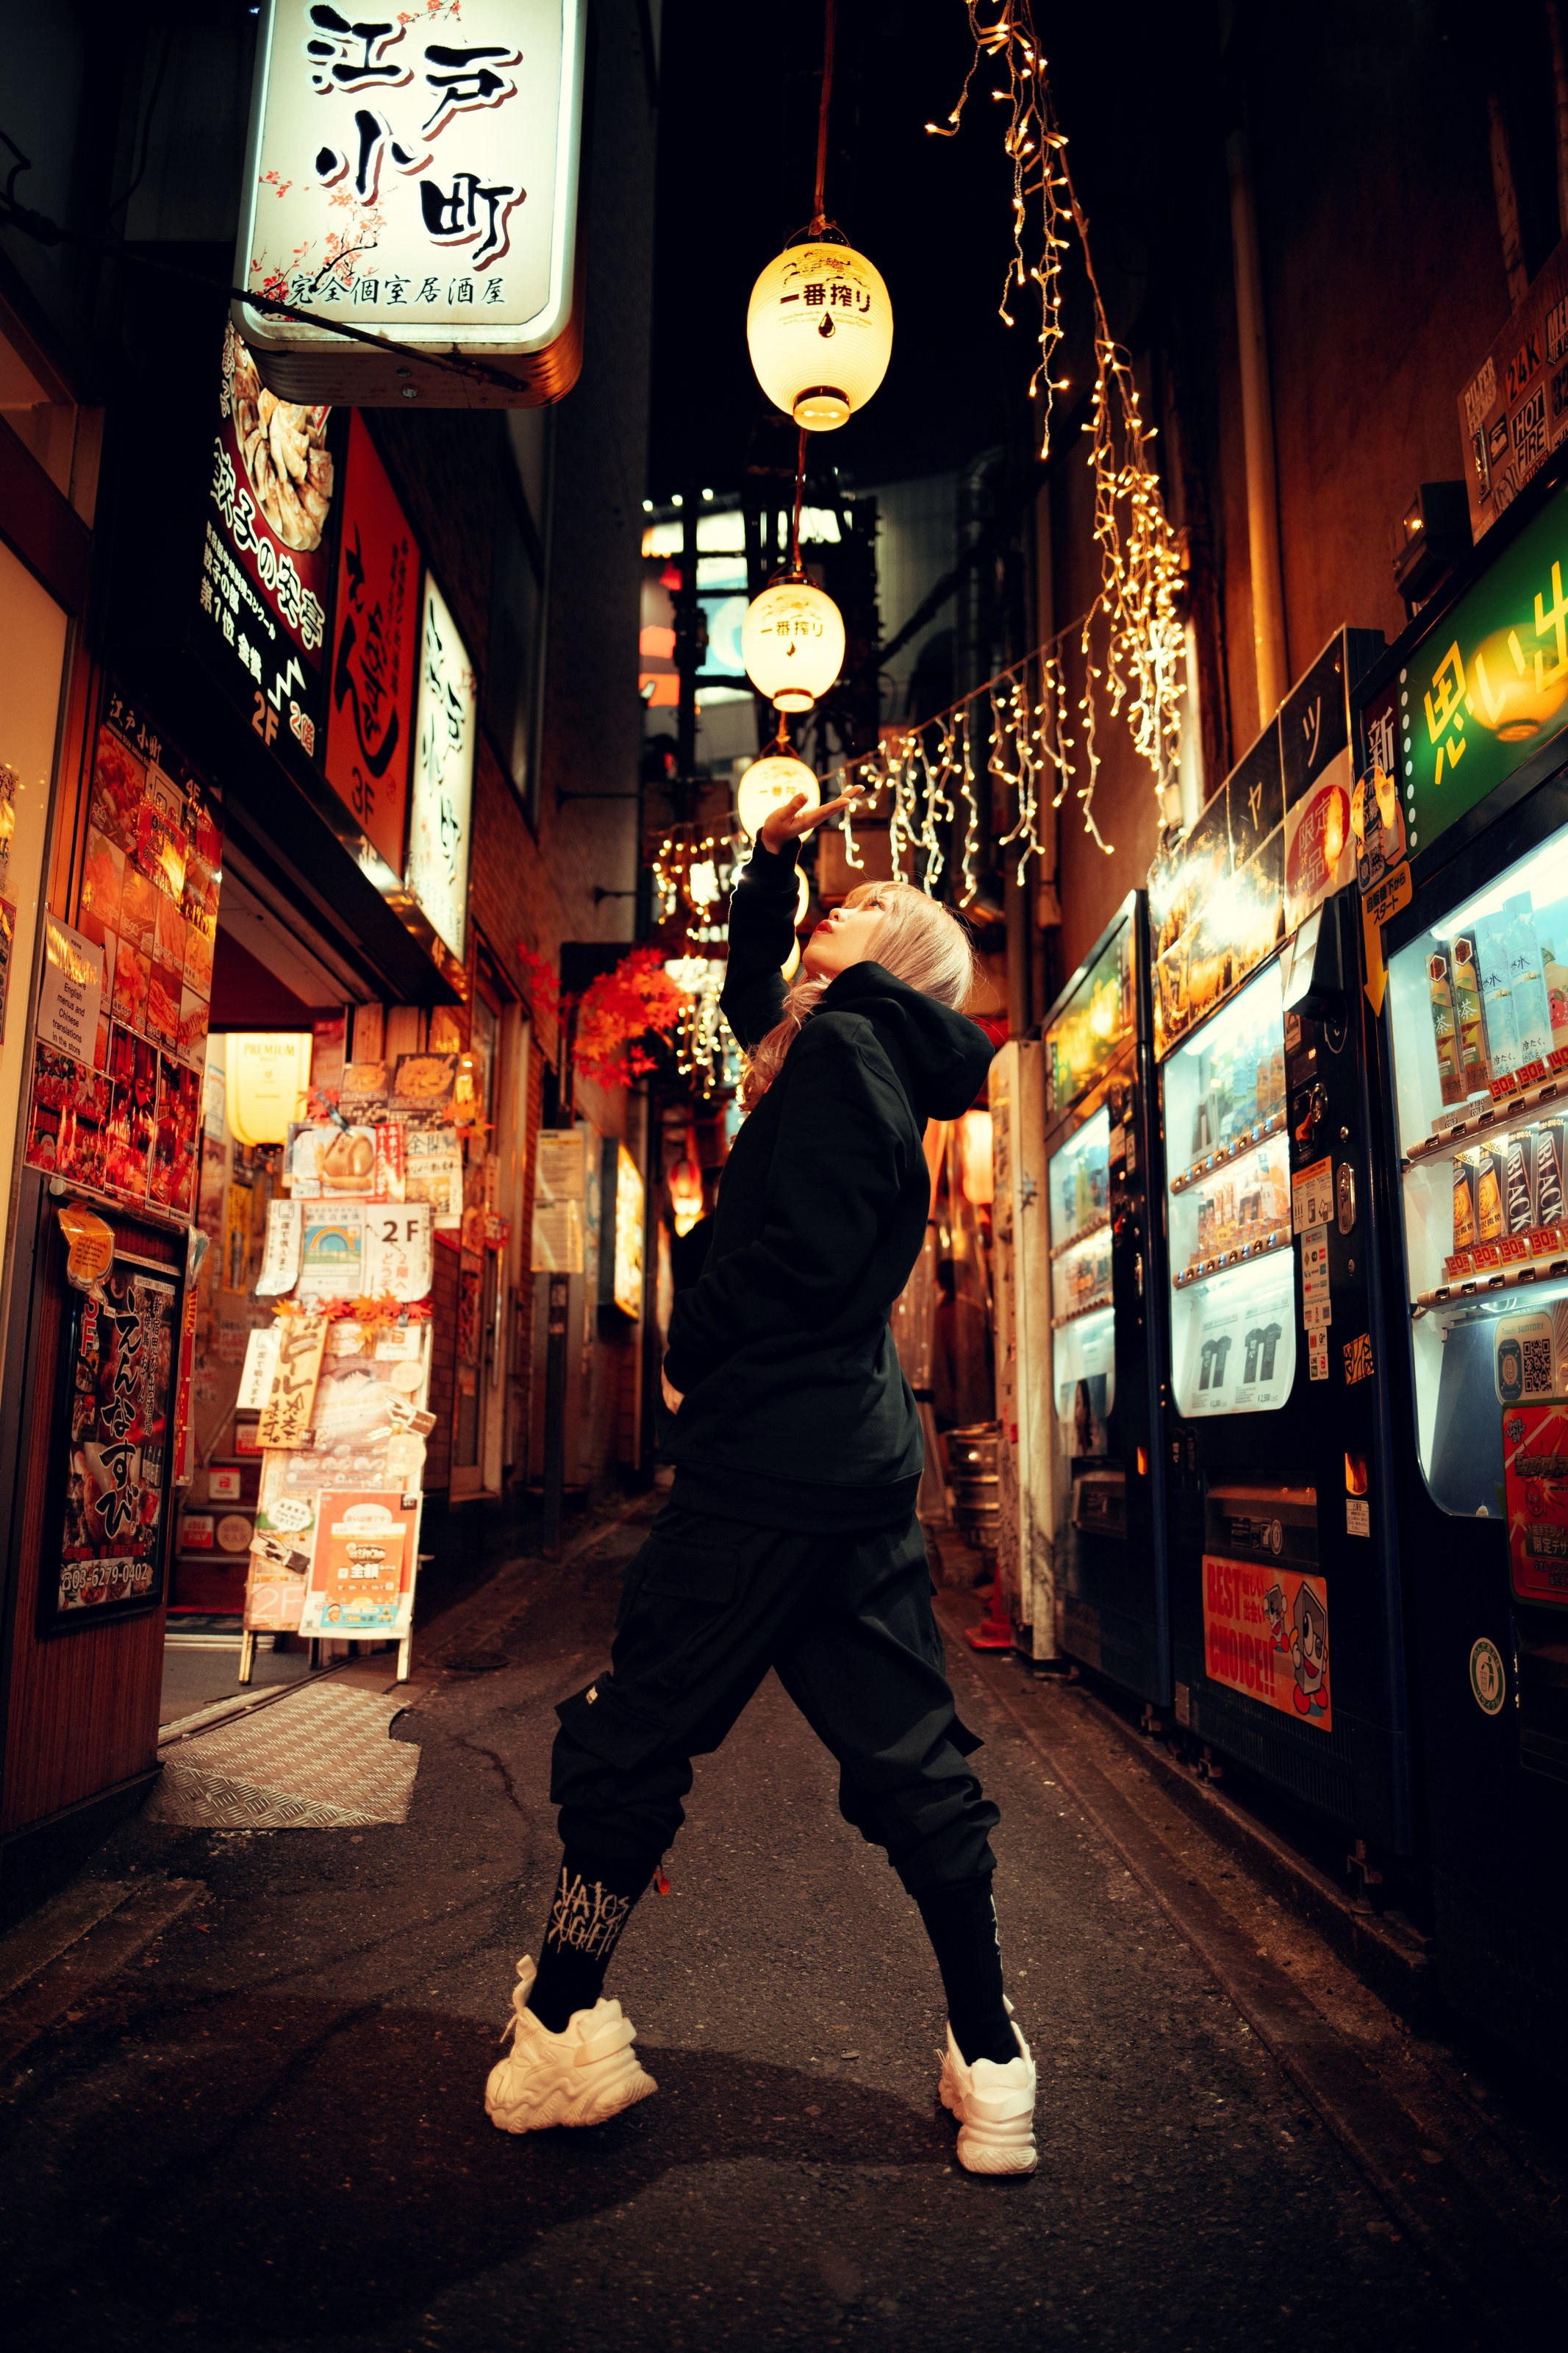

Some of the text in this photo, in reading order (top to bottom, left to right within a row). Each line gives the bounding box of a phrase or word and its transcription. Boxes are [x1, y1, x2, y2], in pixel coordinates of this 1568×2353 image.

[307, 4, 520, 140] 江戸
[314, 109, 523, 269] 小町
[288, 274, 507, 305] 完全個室居酒屋
[780, 283, 870, 313] 一番搾り
[1507, 332, 1542, 404] 24K
[1516, 387, 1543, 445] HOT
[1517, 423, 1545, 475] FIRE
[199, 575, 235, 647] 第1位
[760, 620, 823, 638] 一番搾り
[251, 690, 279, 747] 2F
[290, 700, 315, 757] 2階
[186, 778, 201, 801] 4F
[351, 766, 375, 824] 3F
[1366, 871, 1406, 914] 自販機下から
[1372, 895, 1399, 925] スタート
[64, 982, 82, 1001] English
[78, 981, 87, 990] are
[57, 994, 85, 1017] menus and
[59, 1008, 79, 1028] Chinese
[52, 1032, 81, 1055] in the store
[53, 1019, 82, 1043] translations
[244, 1043, 295, 1057] PREMIUM
[1517, 1062, 1546, 1084] 130円
[1487, 1077, 1516, 1098] 130円
[1445, 1117, 1458, 1127] COLD
[1470, 1106, 1484, 1117] COLD
[1508, 1151, 1533, 1233] BLACK
[1539, 1139, 1564, 1225] BLACK
[1498, 1240, 1525, 1257] 130円
[1528, 1232, 1556, 1249] 130円
[1447, 1255, 1469, 1272] 120円
[1472, 1248, 1497, 1264] 120円
[1502, 1327, 1517, 1335] Touch!
[95, 1285, 143, 1539] えんなすび
[73, 1563, 148, 1590] 03-6279-0402
[253, 1586, 305, 1618] 2F
[1207, 1563, 1242, 1621] BEST
[1209, 1622, 1275, 1698] CHOICE!!
